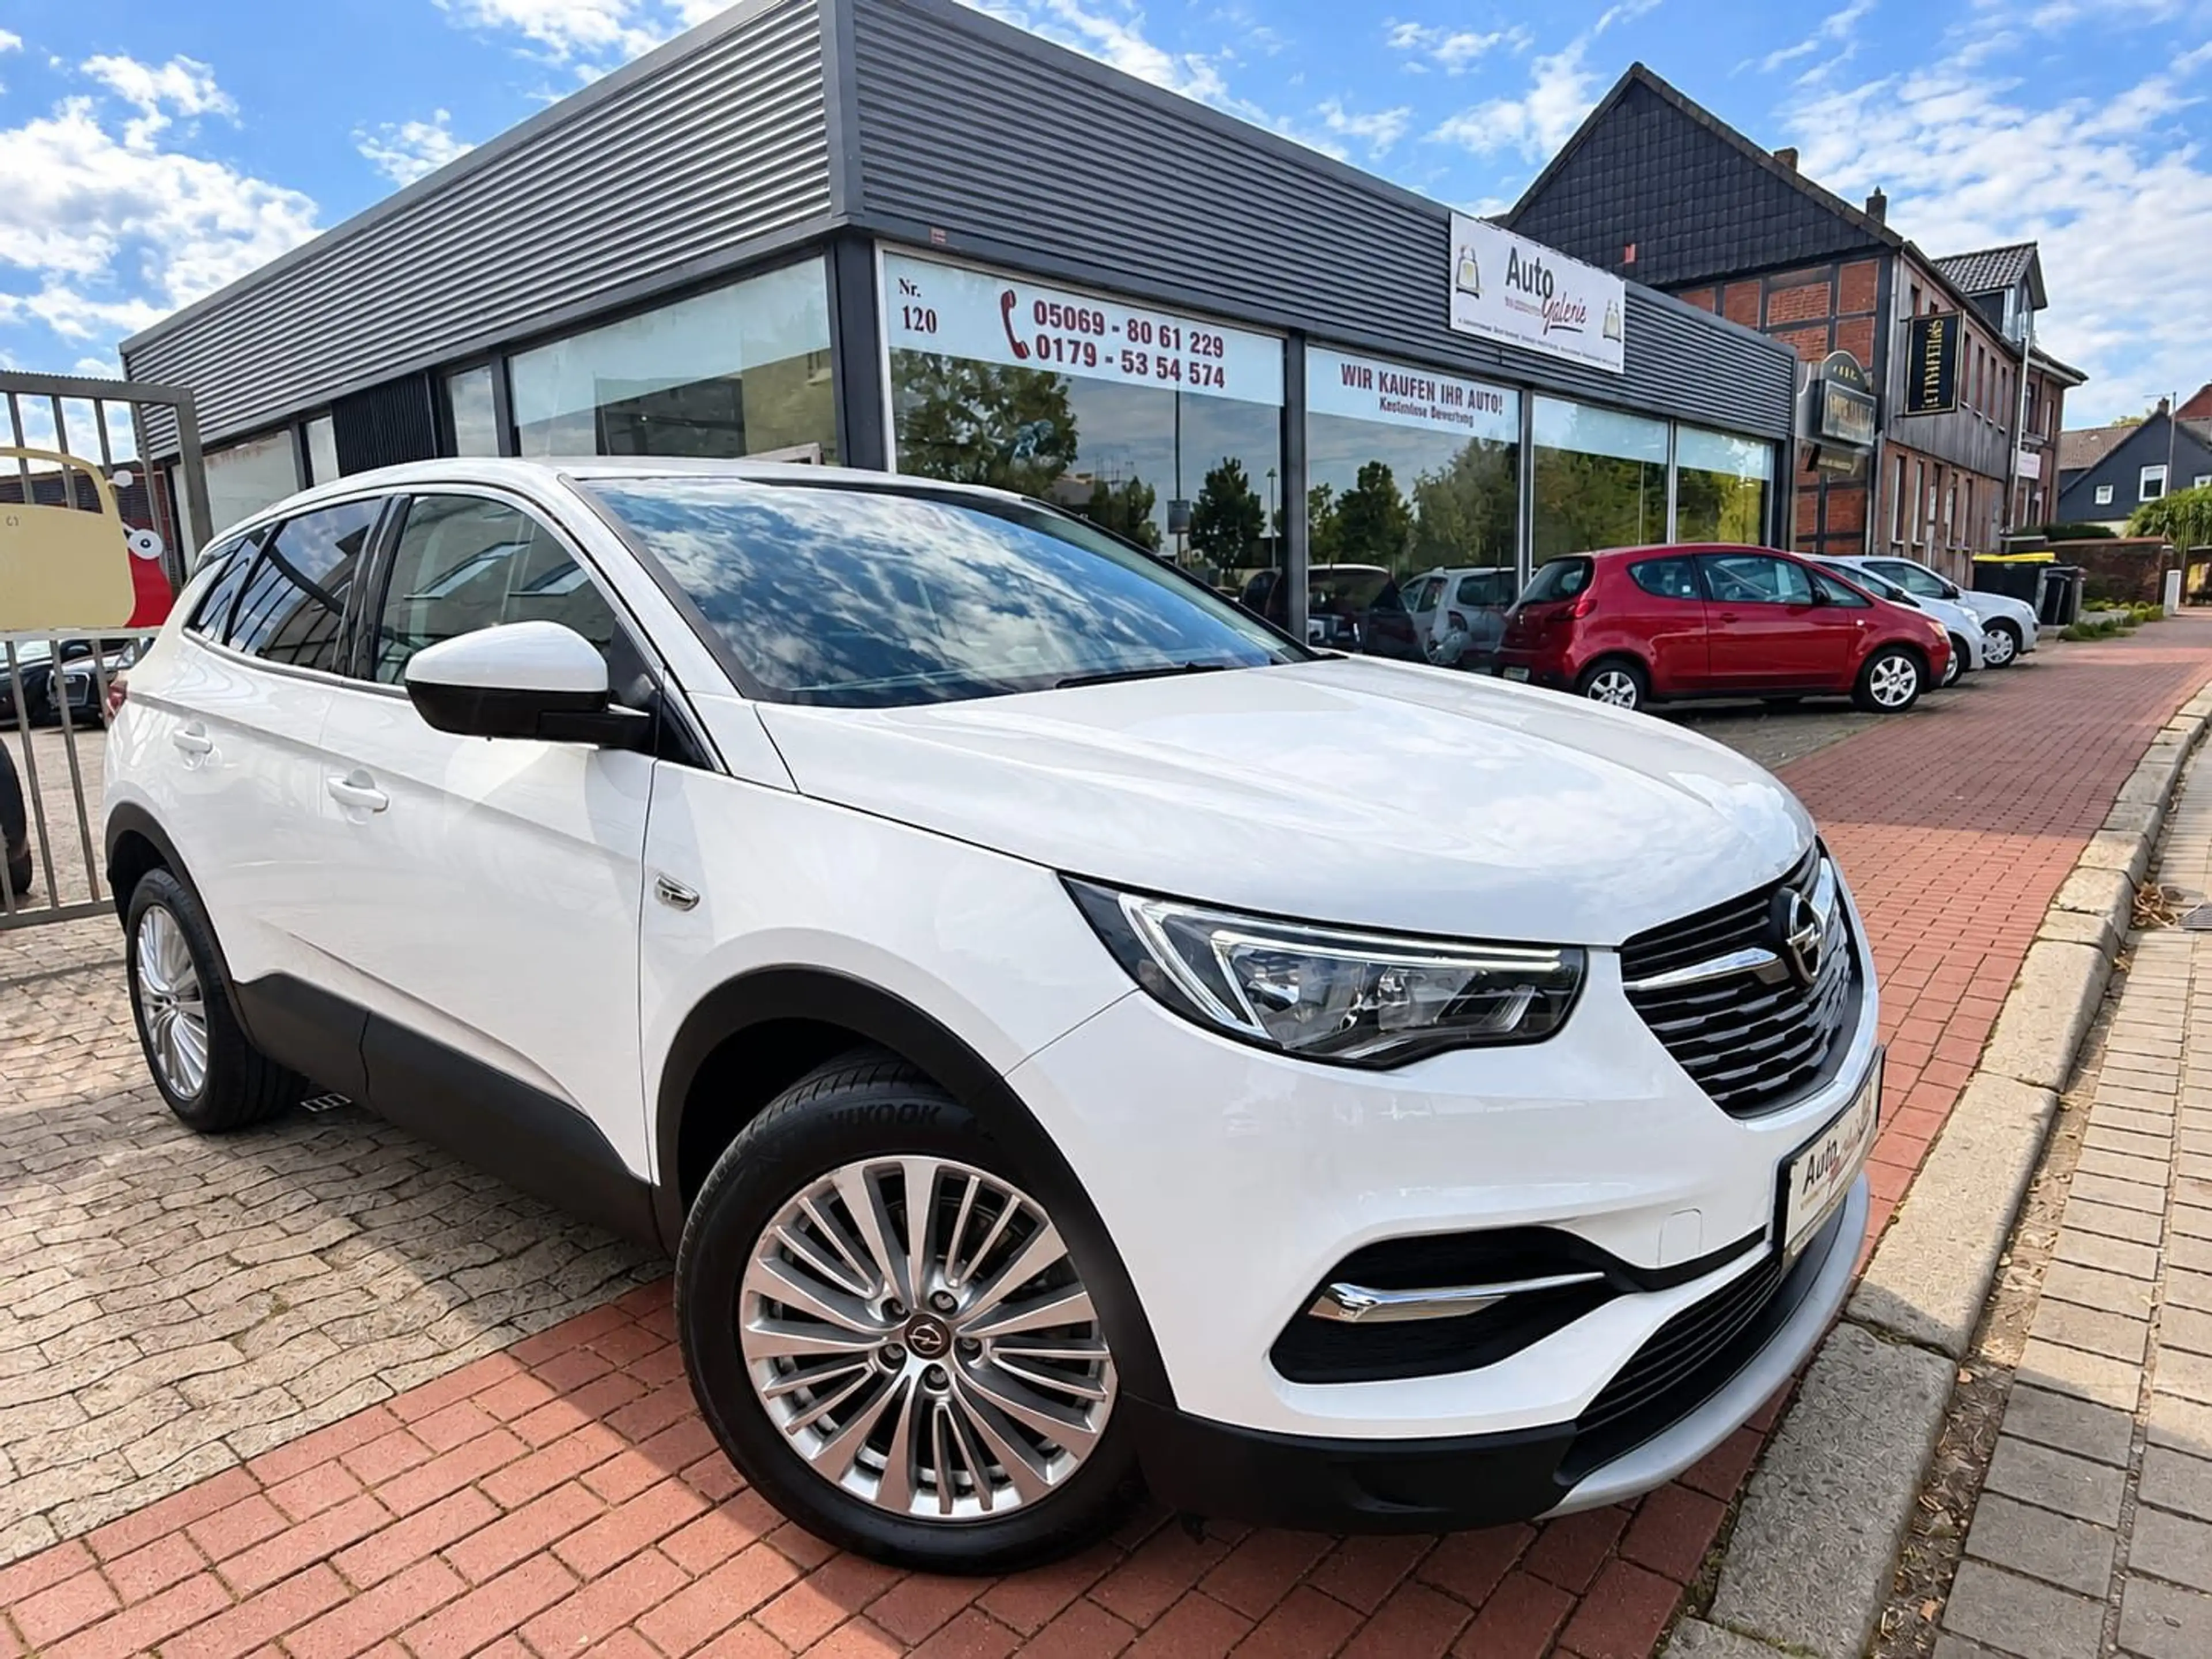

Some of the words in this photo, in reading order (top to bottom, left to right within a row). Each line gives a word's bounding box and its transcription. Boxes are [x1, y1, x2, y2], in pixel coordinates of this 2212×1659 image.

[897, 276, 922, 298] Nr.
[1506, 247, 1554, 299] Auto
[903, 304, 937, 334] 120
[1033, 300, 1105, 336] 05069
[1127, 318, 1152, 345] 80
[1159, 324, 1181, 351] 61
[1190, 331, 1224, 359] 229
[1036, 333, 1097, 368] 0179
[1121, 349, 1149, 376] 53
[1156, 355, 1182, 382] 54
[1189, 361, 1225, 389] 574
[1340, 363, 1373, 391] WIR
[1378, 370, 1436, 403] KAUFEN
[1441, 385, 1463, 407] IHR
[1467, 389, 1503, 416] AUTO!
